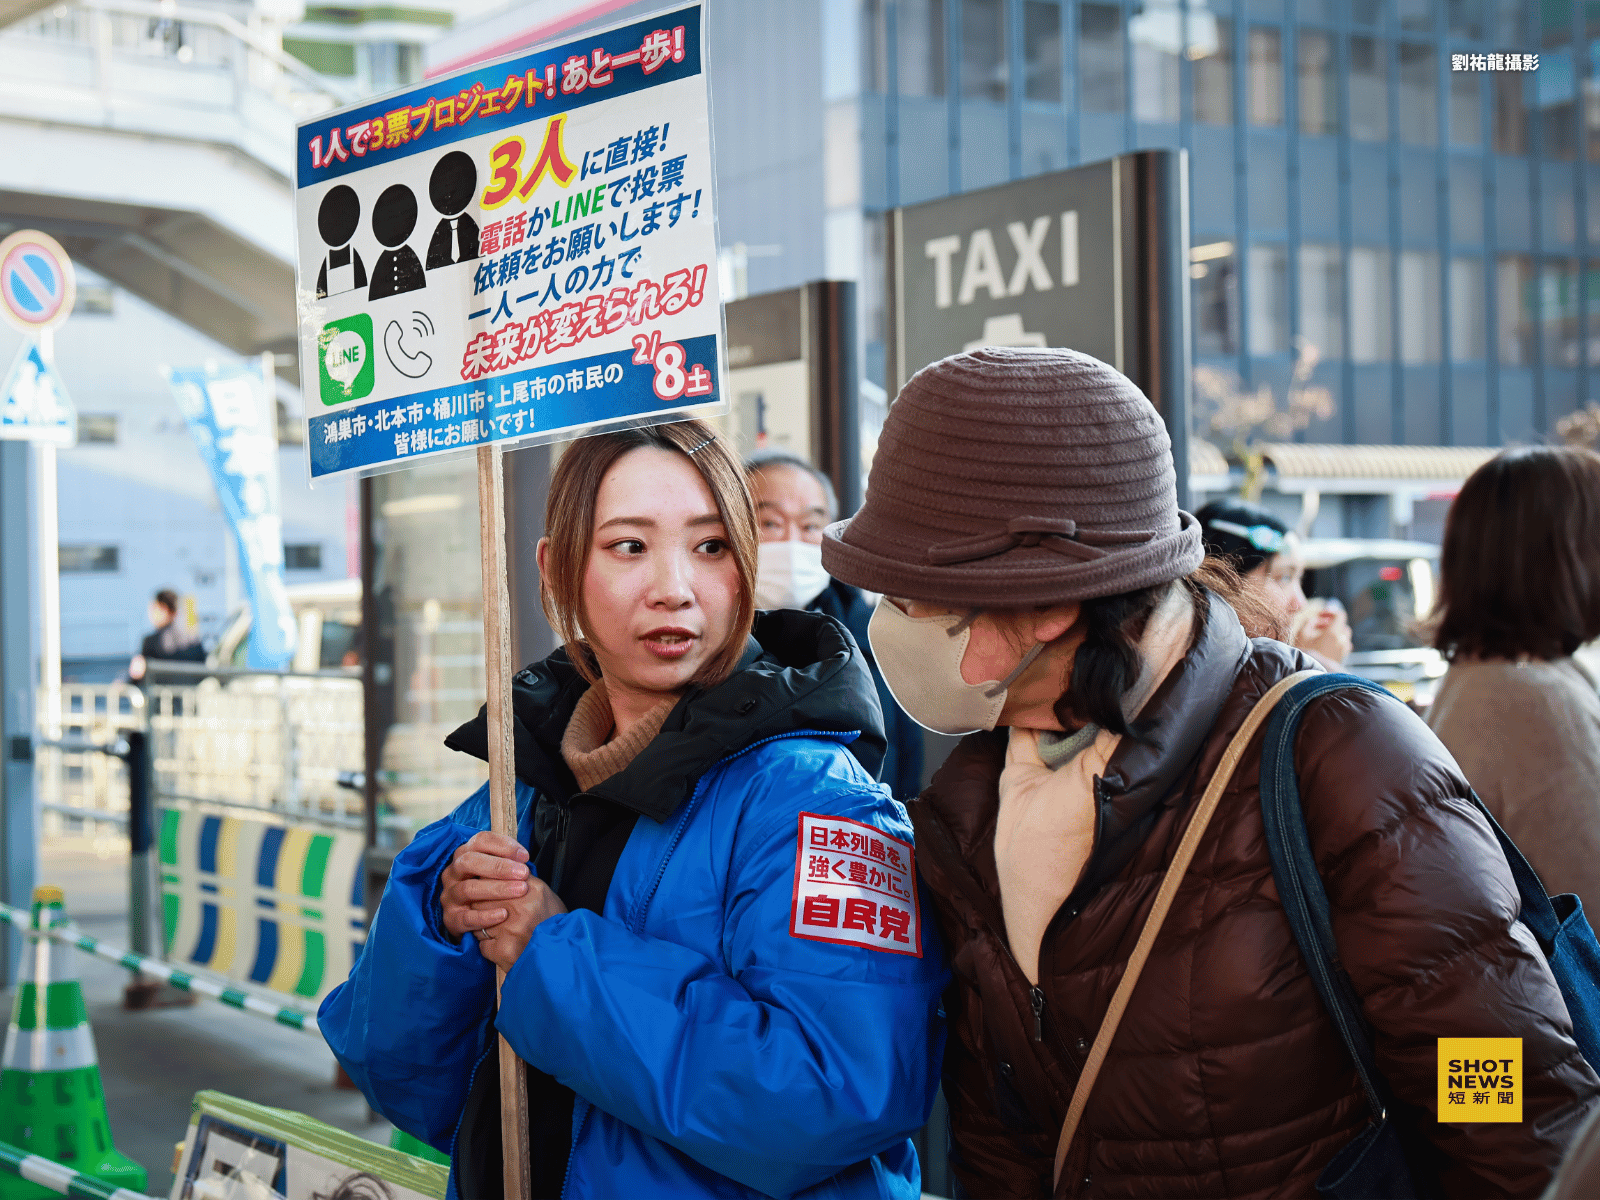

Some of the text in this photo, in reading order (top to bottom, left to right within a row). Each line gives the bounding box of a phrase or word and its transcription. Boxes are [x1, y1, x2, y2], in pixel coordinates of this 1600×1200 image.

[472, 189, 702, 295] 依頼をお願いします!
[925, 210, 1080, 308] TAXI
[467, 246, 642, 324] 一人一人の力で
[460, 264, 708, 380] 未来が変えられる!
[333, 346, 359, 367] LINE
[394, 408, 535, 455] 皆様にお願いです!
[810, 825, 907, 871] 日本列島を、
[808, 855, 911, 898] 強く豊かに。
[802, 894, 911, 943] 自民党
